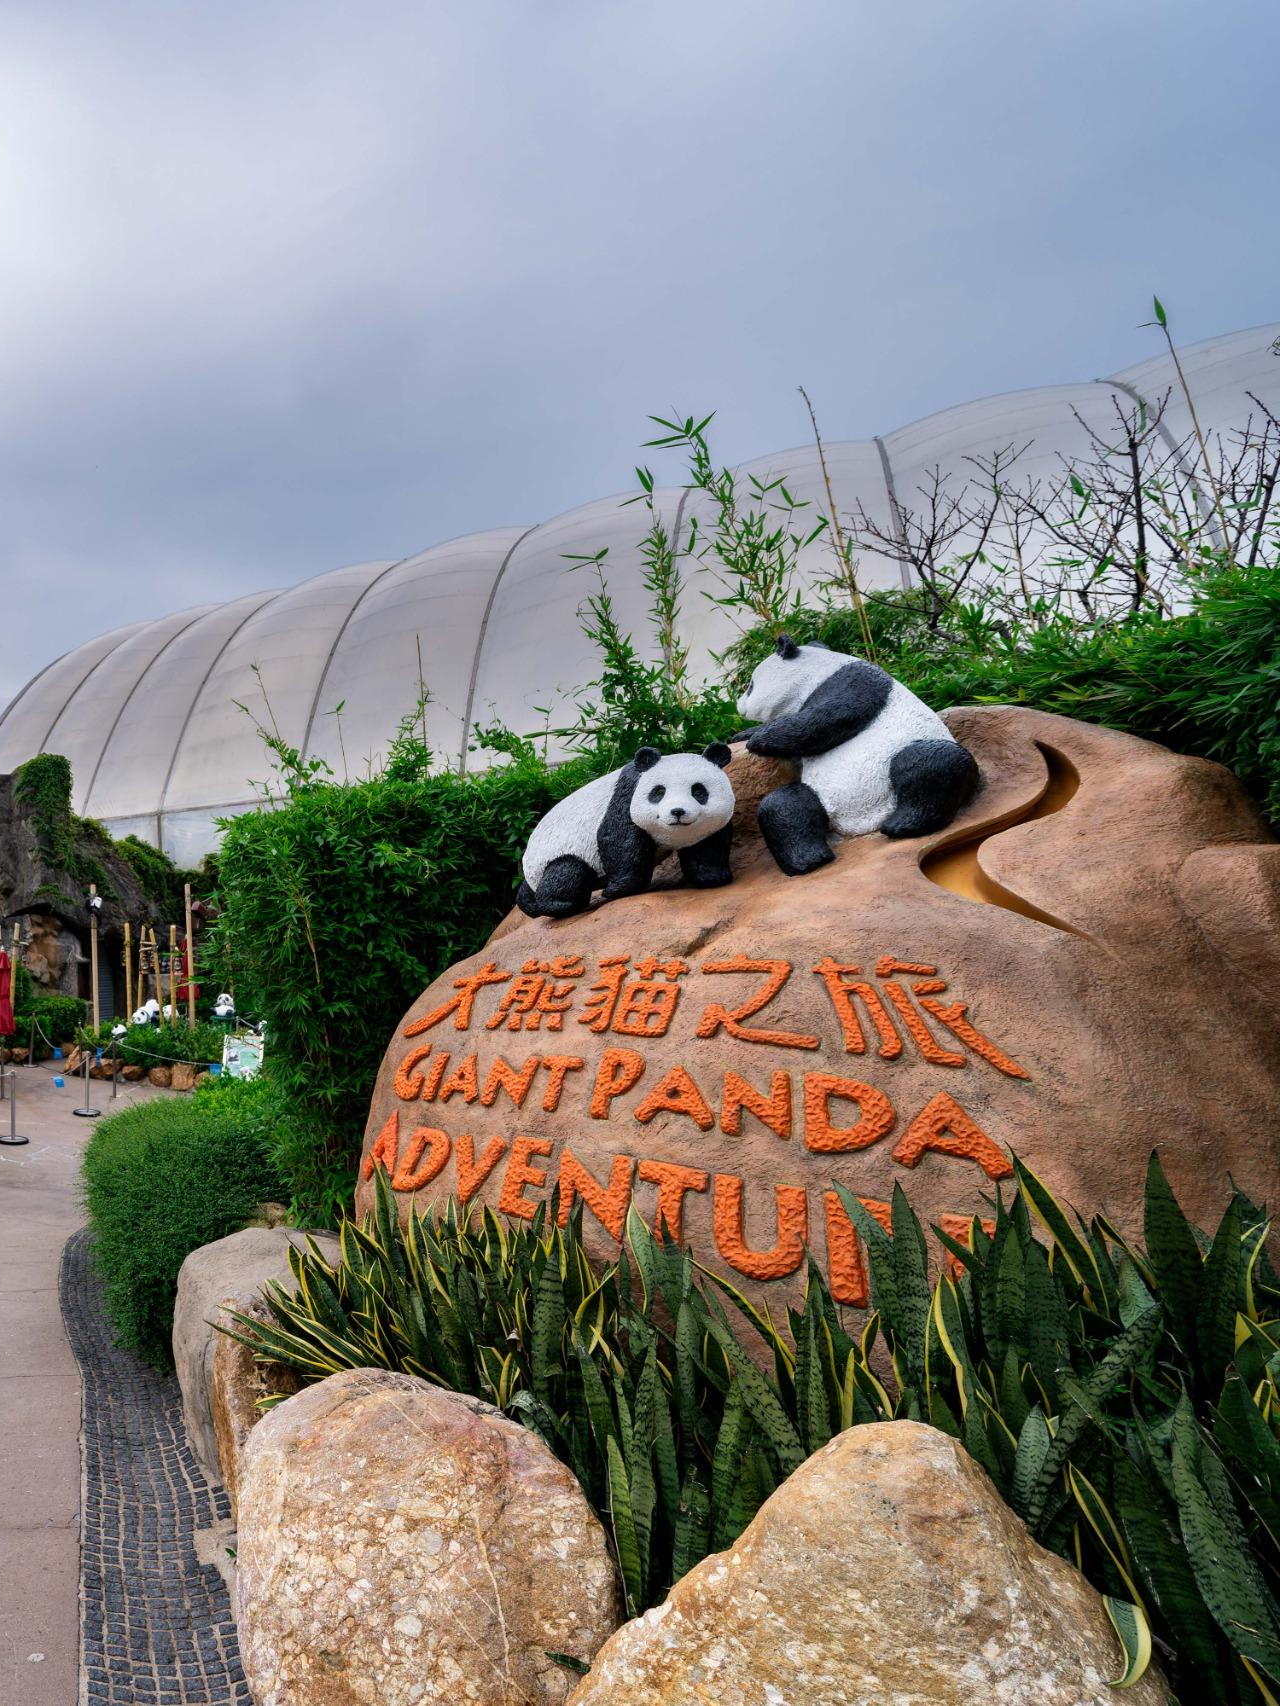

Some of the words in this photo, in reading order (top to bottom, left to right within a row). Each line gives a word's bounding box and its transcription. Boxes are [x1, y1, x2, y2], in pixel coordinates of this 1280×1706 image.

[403, 954, 1032, 1082] 大熊貓之旅
[394, 1042, 585, 1112] GIANT
[591, 1048, 1015, 1180] PANDA
